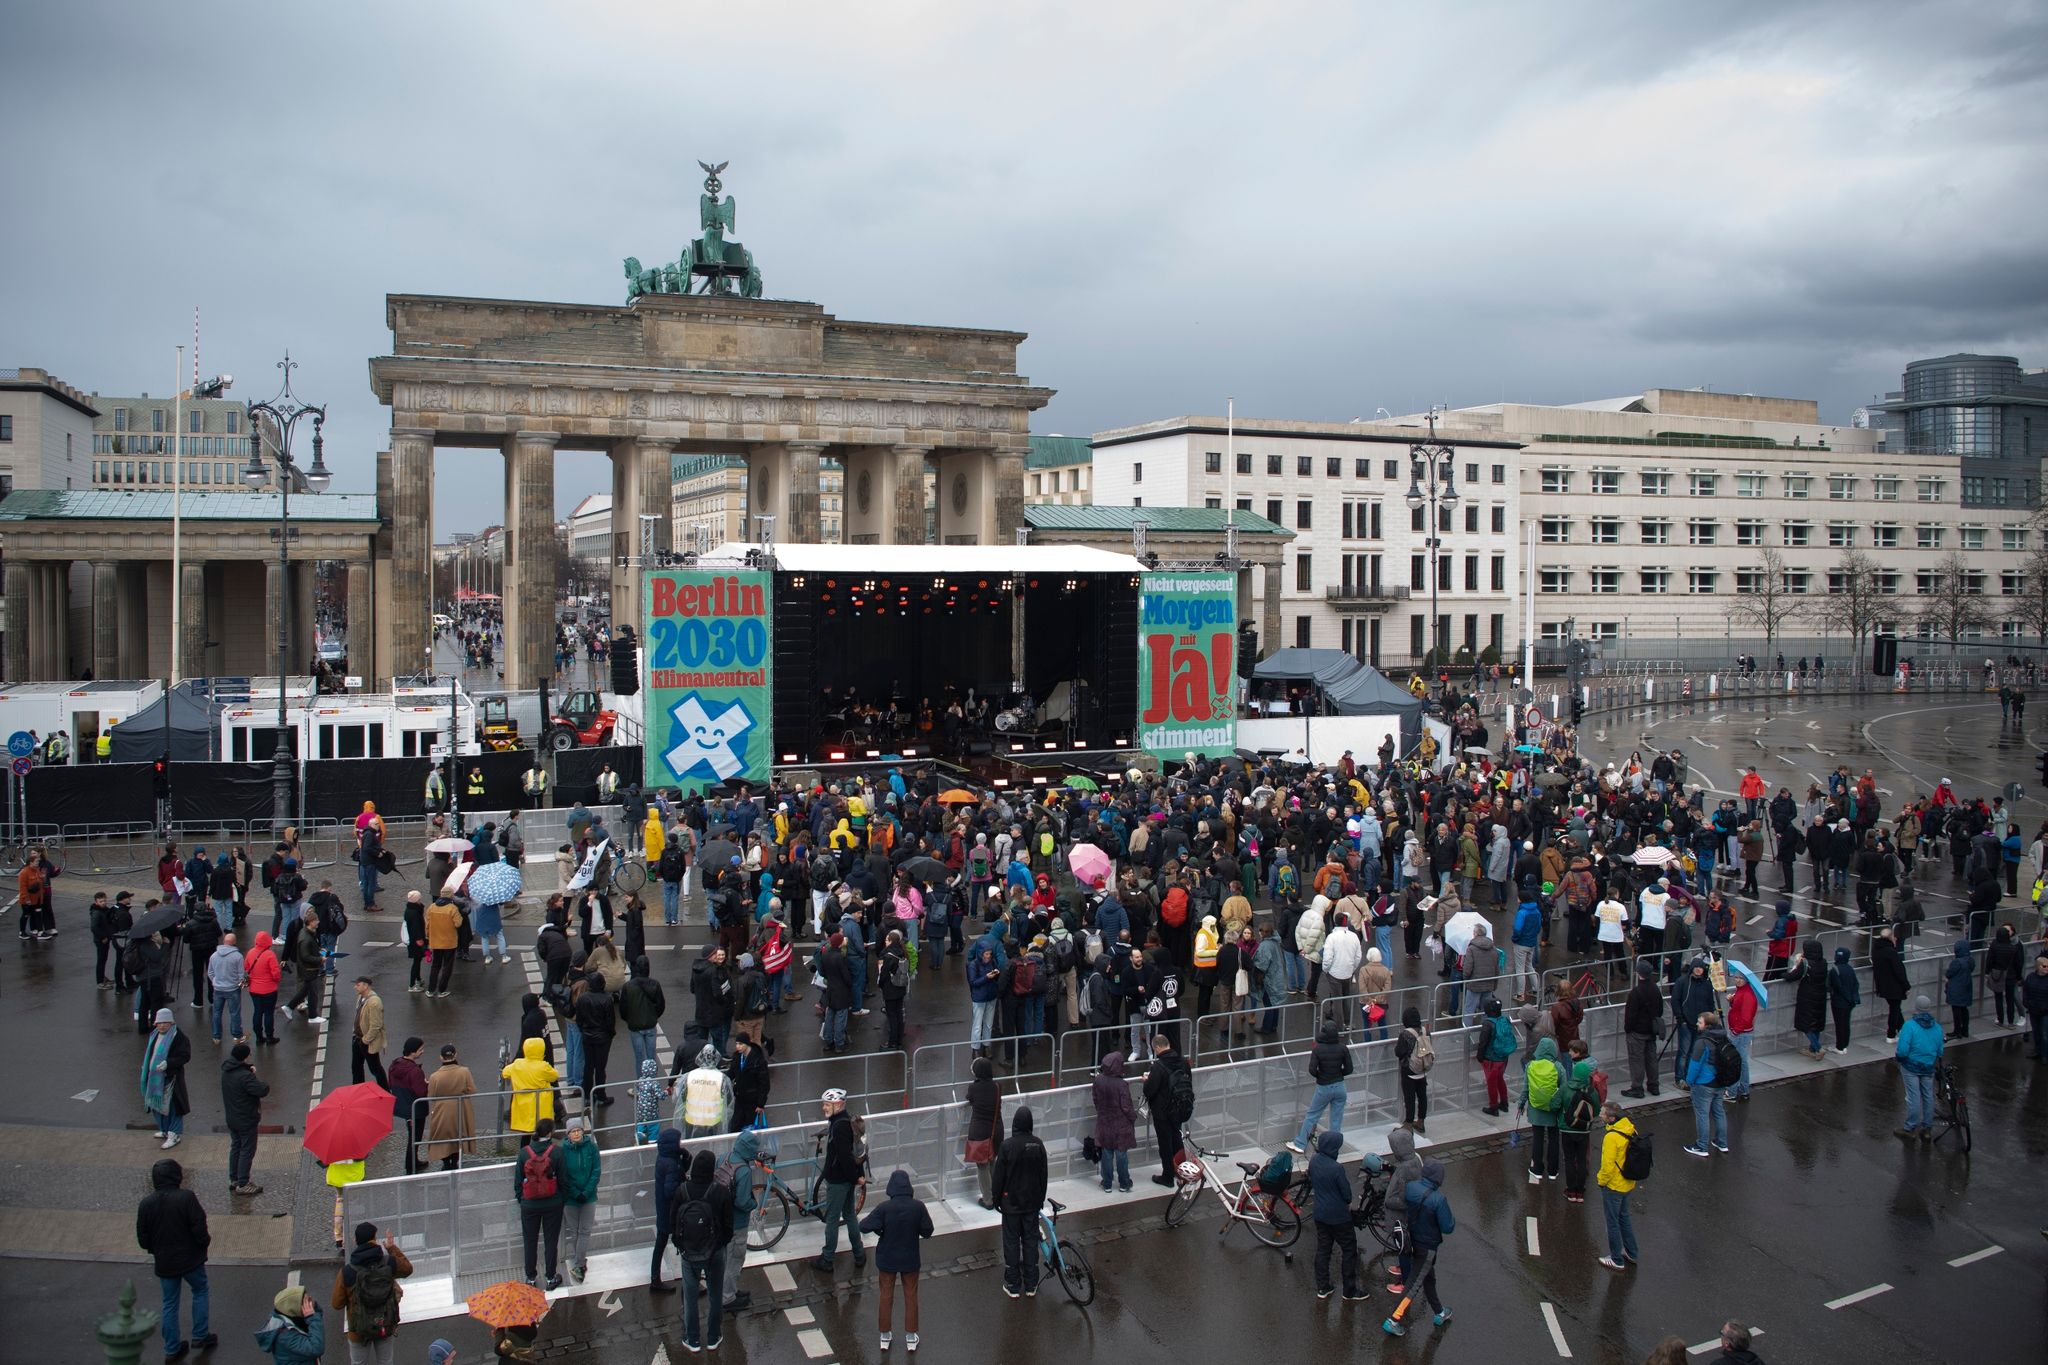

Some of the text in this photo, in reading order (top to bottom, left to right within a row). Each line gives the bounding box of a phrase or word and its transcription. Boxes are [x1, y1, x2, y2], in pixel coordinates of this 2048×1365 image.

[651, 576, 766, 617] Berlin
[1144, 577, 1233, 594] Nicht vergessen!
[1143, 595, 1233, 630] Morgen
[650, 618, 767, 668] 2030
[1180, 633, 1196, 645] mit
[651, 668, 766, 688] Klimaneutral
[1143, 632, 1232, 724] Ja!
[1144, 724, 1233, 750] stimmen!
